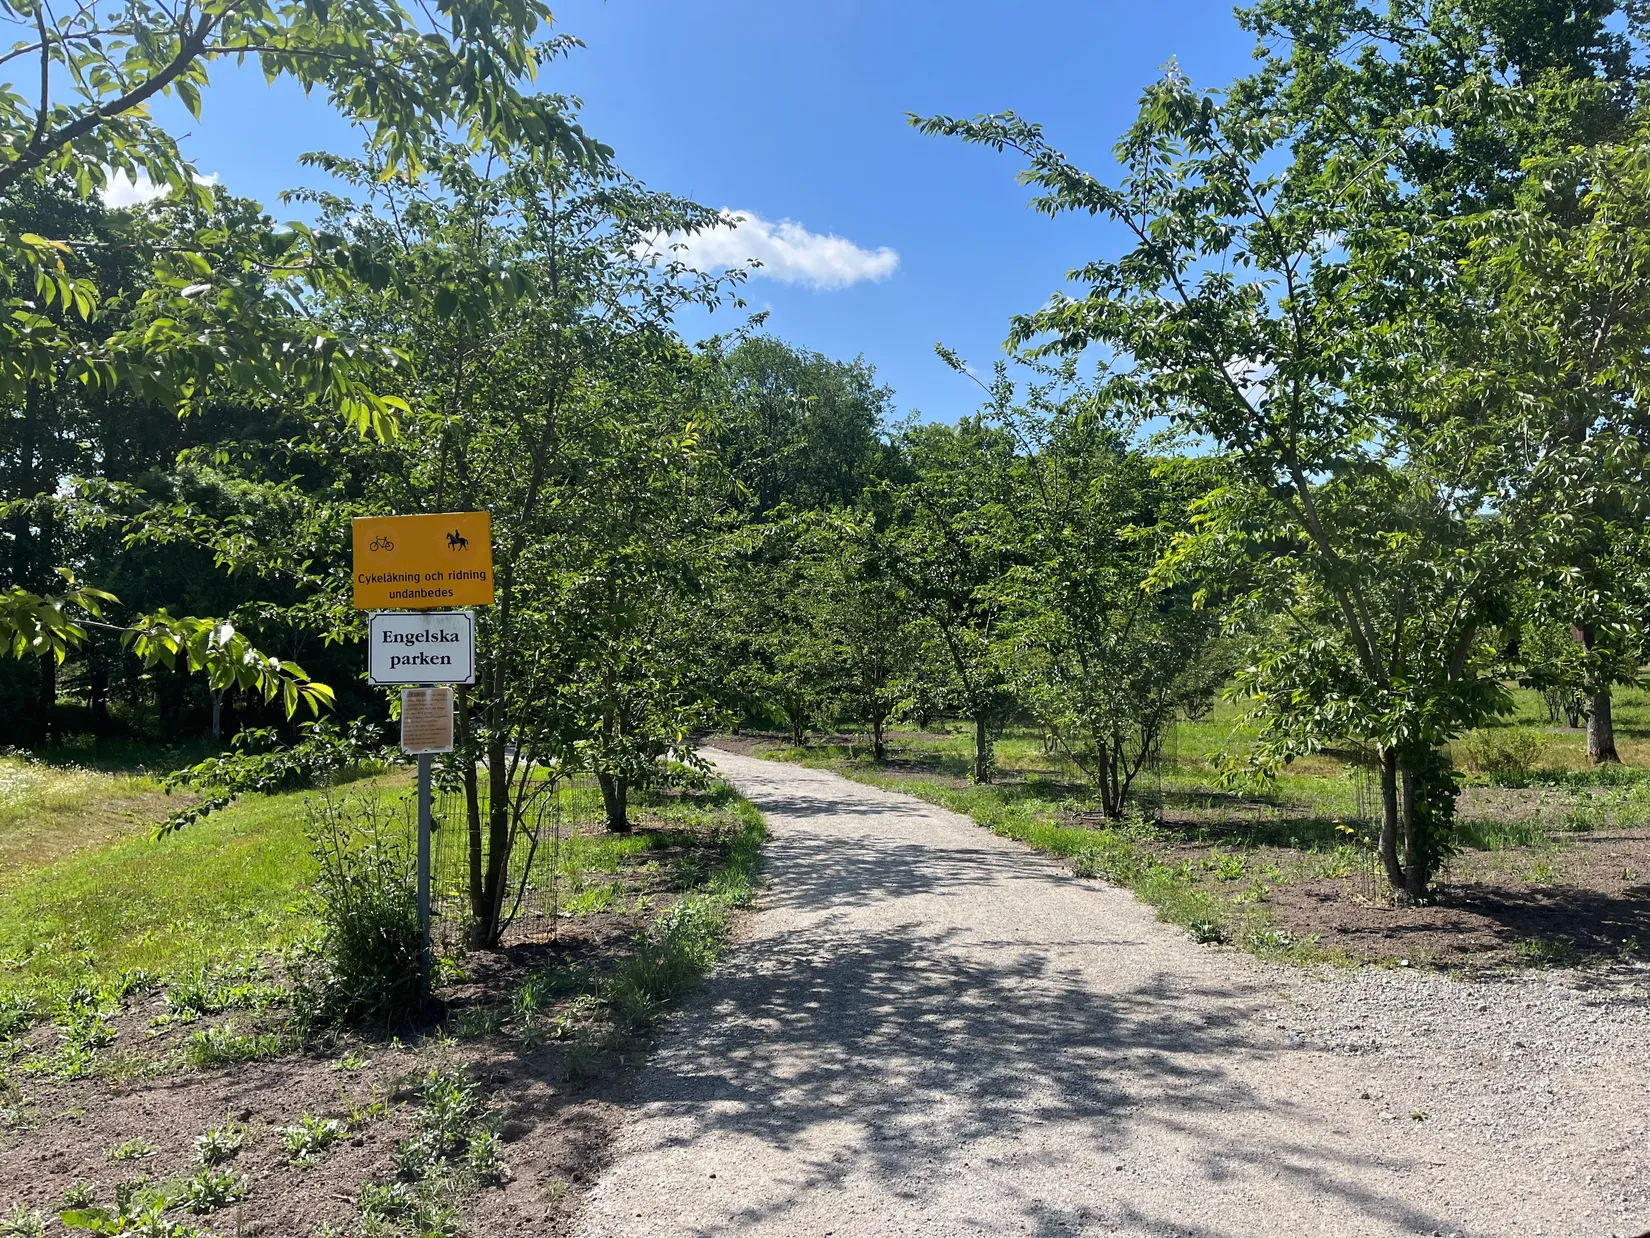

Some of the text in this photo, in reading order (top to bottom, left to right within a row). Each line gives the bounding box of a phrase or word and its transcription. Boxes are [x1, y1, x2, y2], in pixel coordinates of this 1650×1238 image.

[358, 570, 486, 585] Cykelåkning och ridning
[389, 588, 453, 599] undanbedes
[382, 629, 460, 647] Engelska
[389, 652, 452, 670] parken
